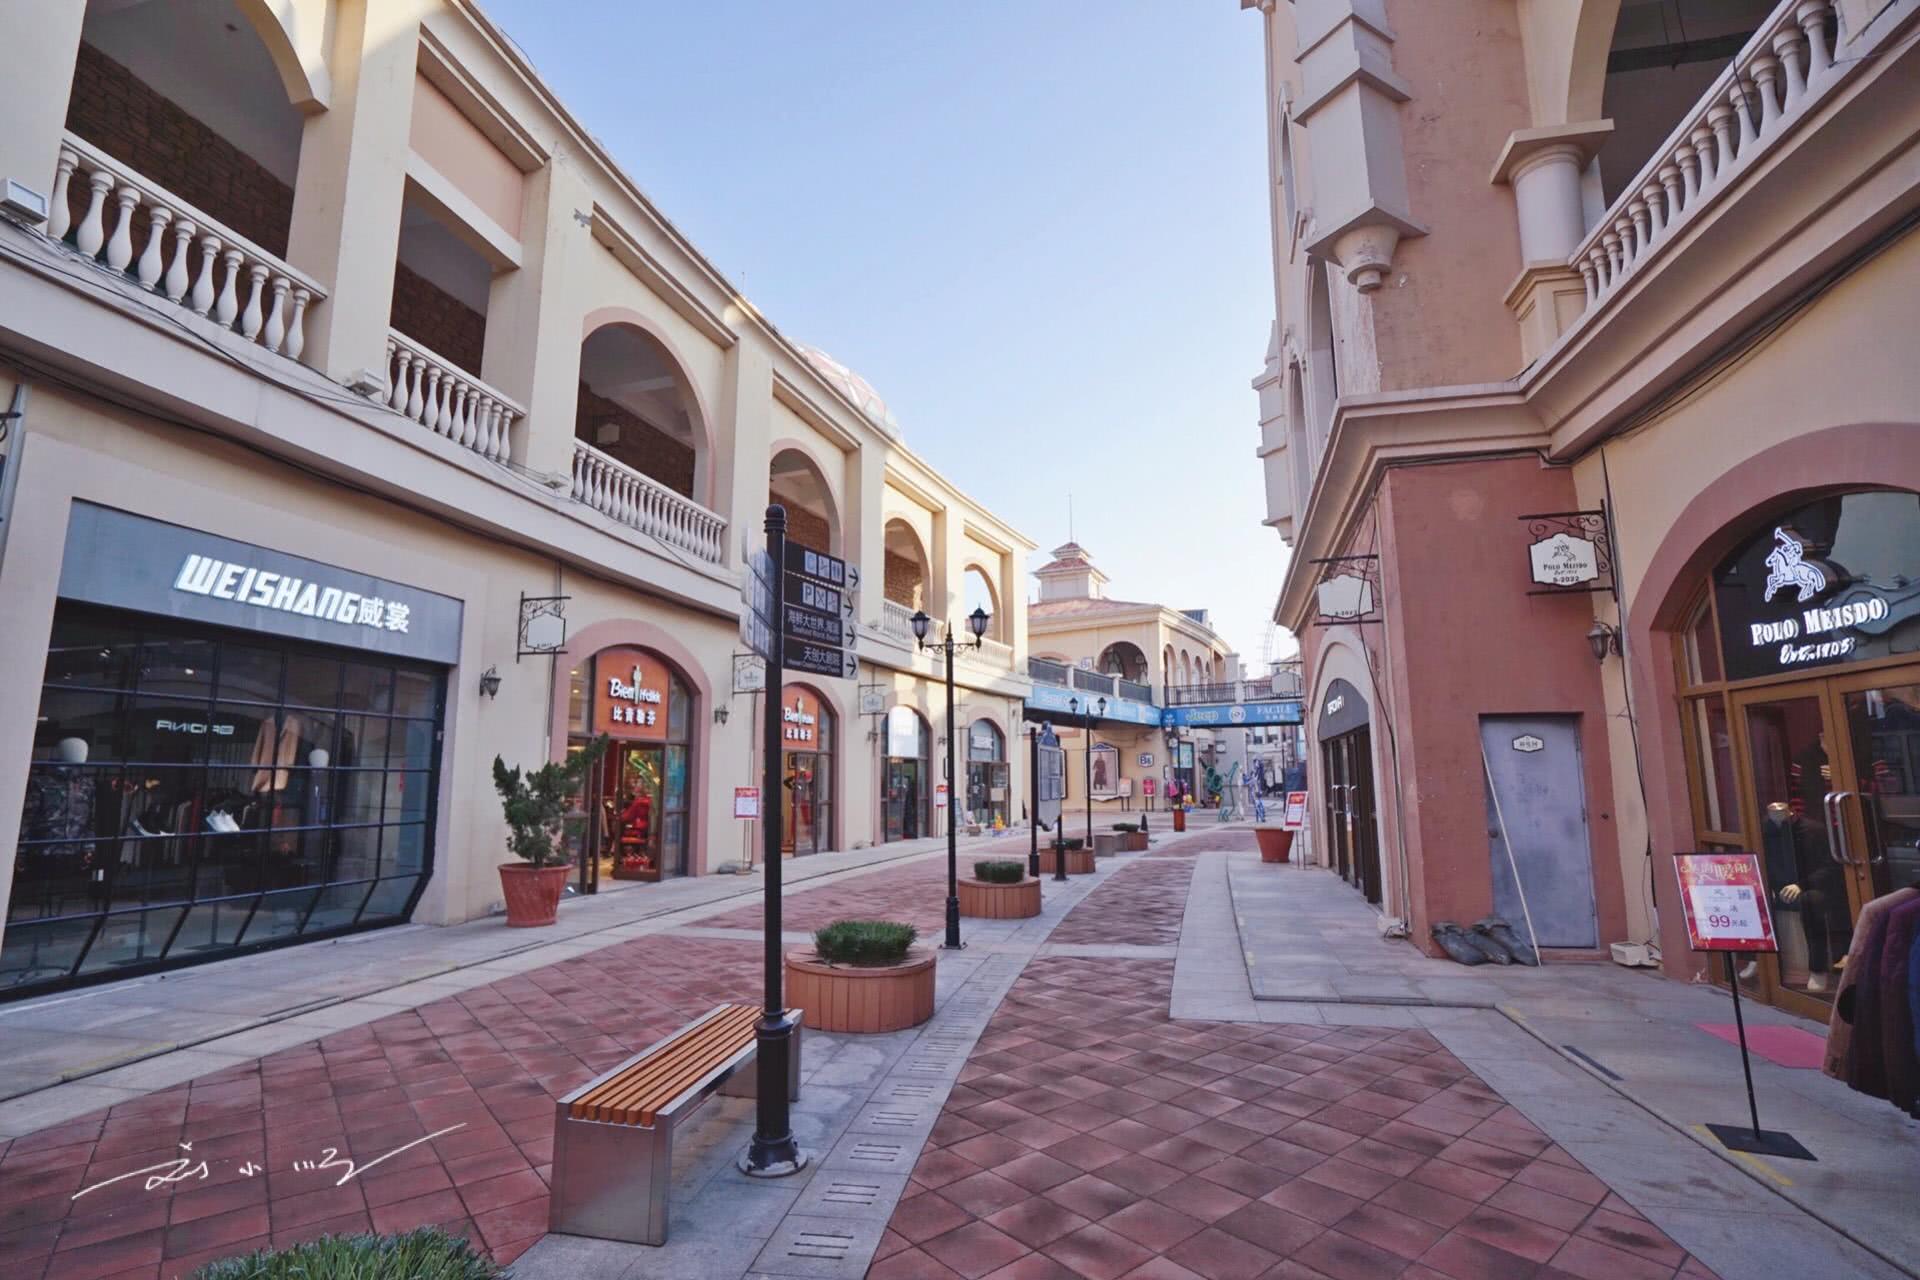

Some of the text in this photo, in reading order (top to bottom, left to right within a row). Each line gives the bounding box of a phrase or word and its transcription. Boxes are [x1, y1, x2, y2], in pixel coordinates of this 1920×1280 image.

[174, 554, 411, 634] WEISHANG 威裳
[1751, 597, 1888, 646] POLO MEISDO
